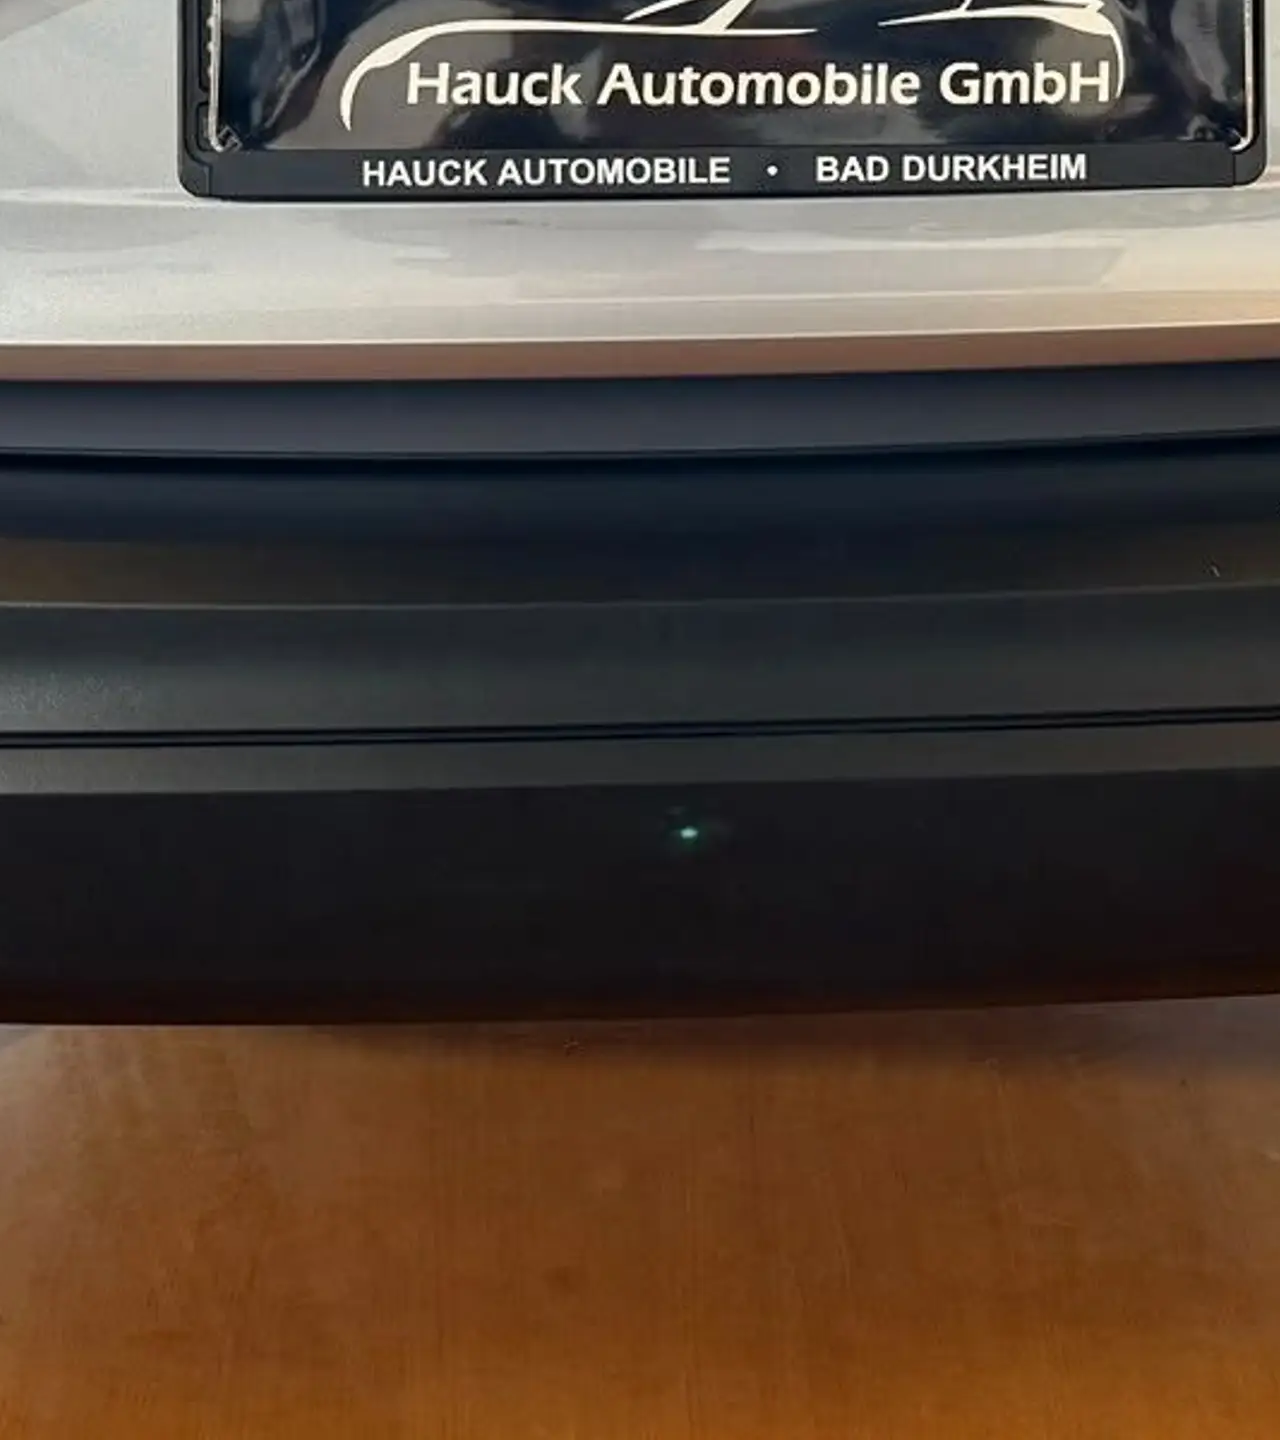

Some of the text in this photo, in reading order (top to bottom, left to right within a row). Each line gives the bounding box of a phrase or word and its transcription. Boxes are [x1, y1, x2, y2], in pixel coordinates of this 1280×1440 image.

[405, 60, 1111, 107] Hauck Automobile GmbH
[361, 153, 1088, 187] HAUCK AUTOMOBILE BAD DURKHEIM
